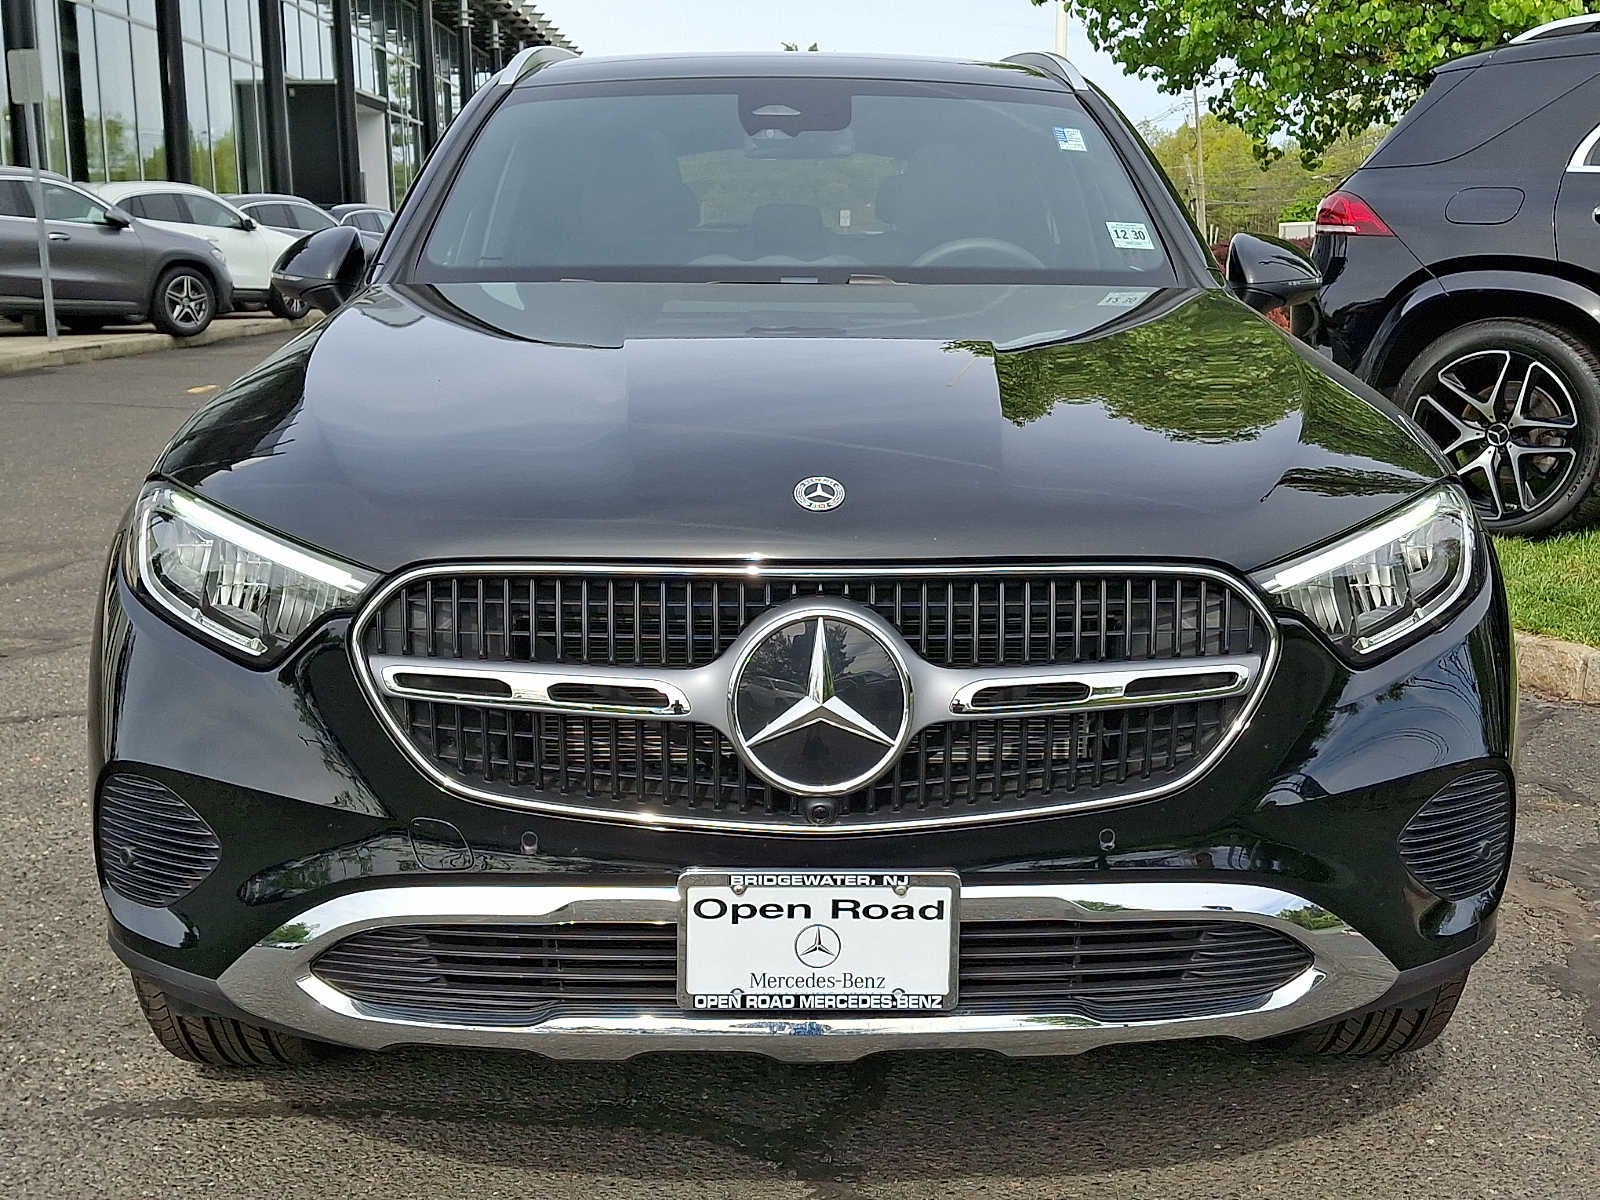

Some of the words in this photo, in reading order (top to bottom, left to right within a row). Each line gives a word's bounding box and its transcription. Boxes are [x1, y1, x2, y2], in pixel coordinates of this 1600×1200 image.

[1114, 229, 1128, 239] 12
[1131, 230, 1145, 240] 30
[730, 875, 875, 886] BRIDGEWATER,
[883, 875, 909, 886] NJ
[693, 898, 811, 924] Open
[831, 899, 944, 920] Road
[749, 972, 886, 989] Mercedes-Benz
[694, 995, 741, 1009] OPEN
[746, 995, 795, 1009] ROAD
